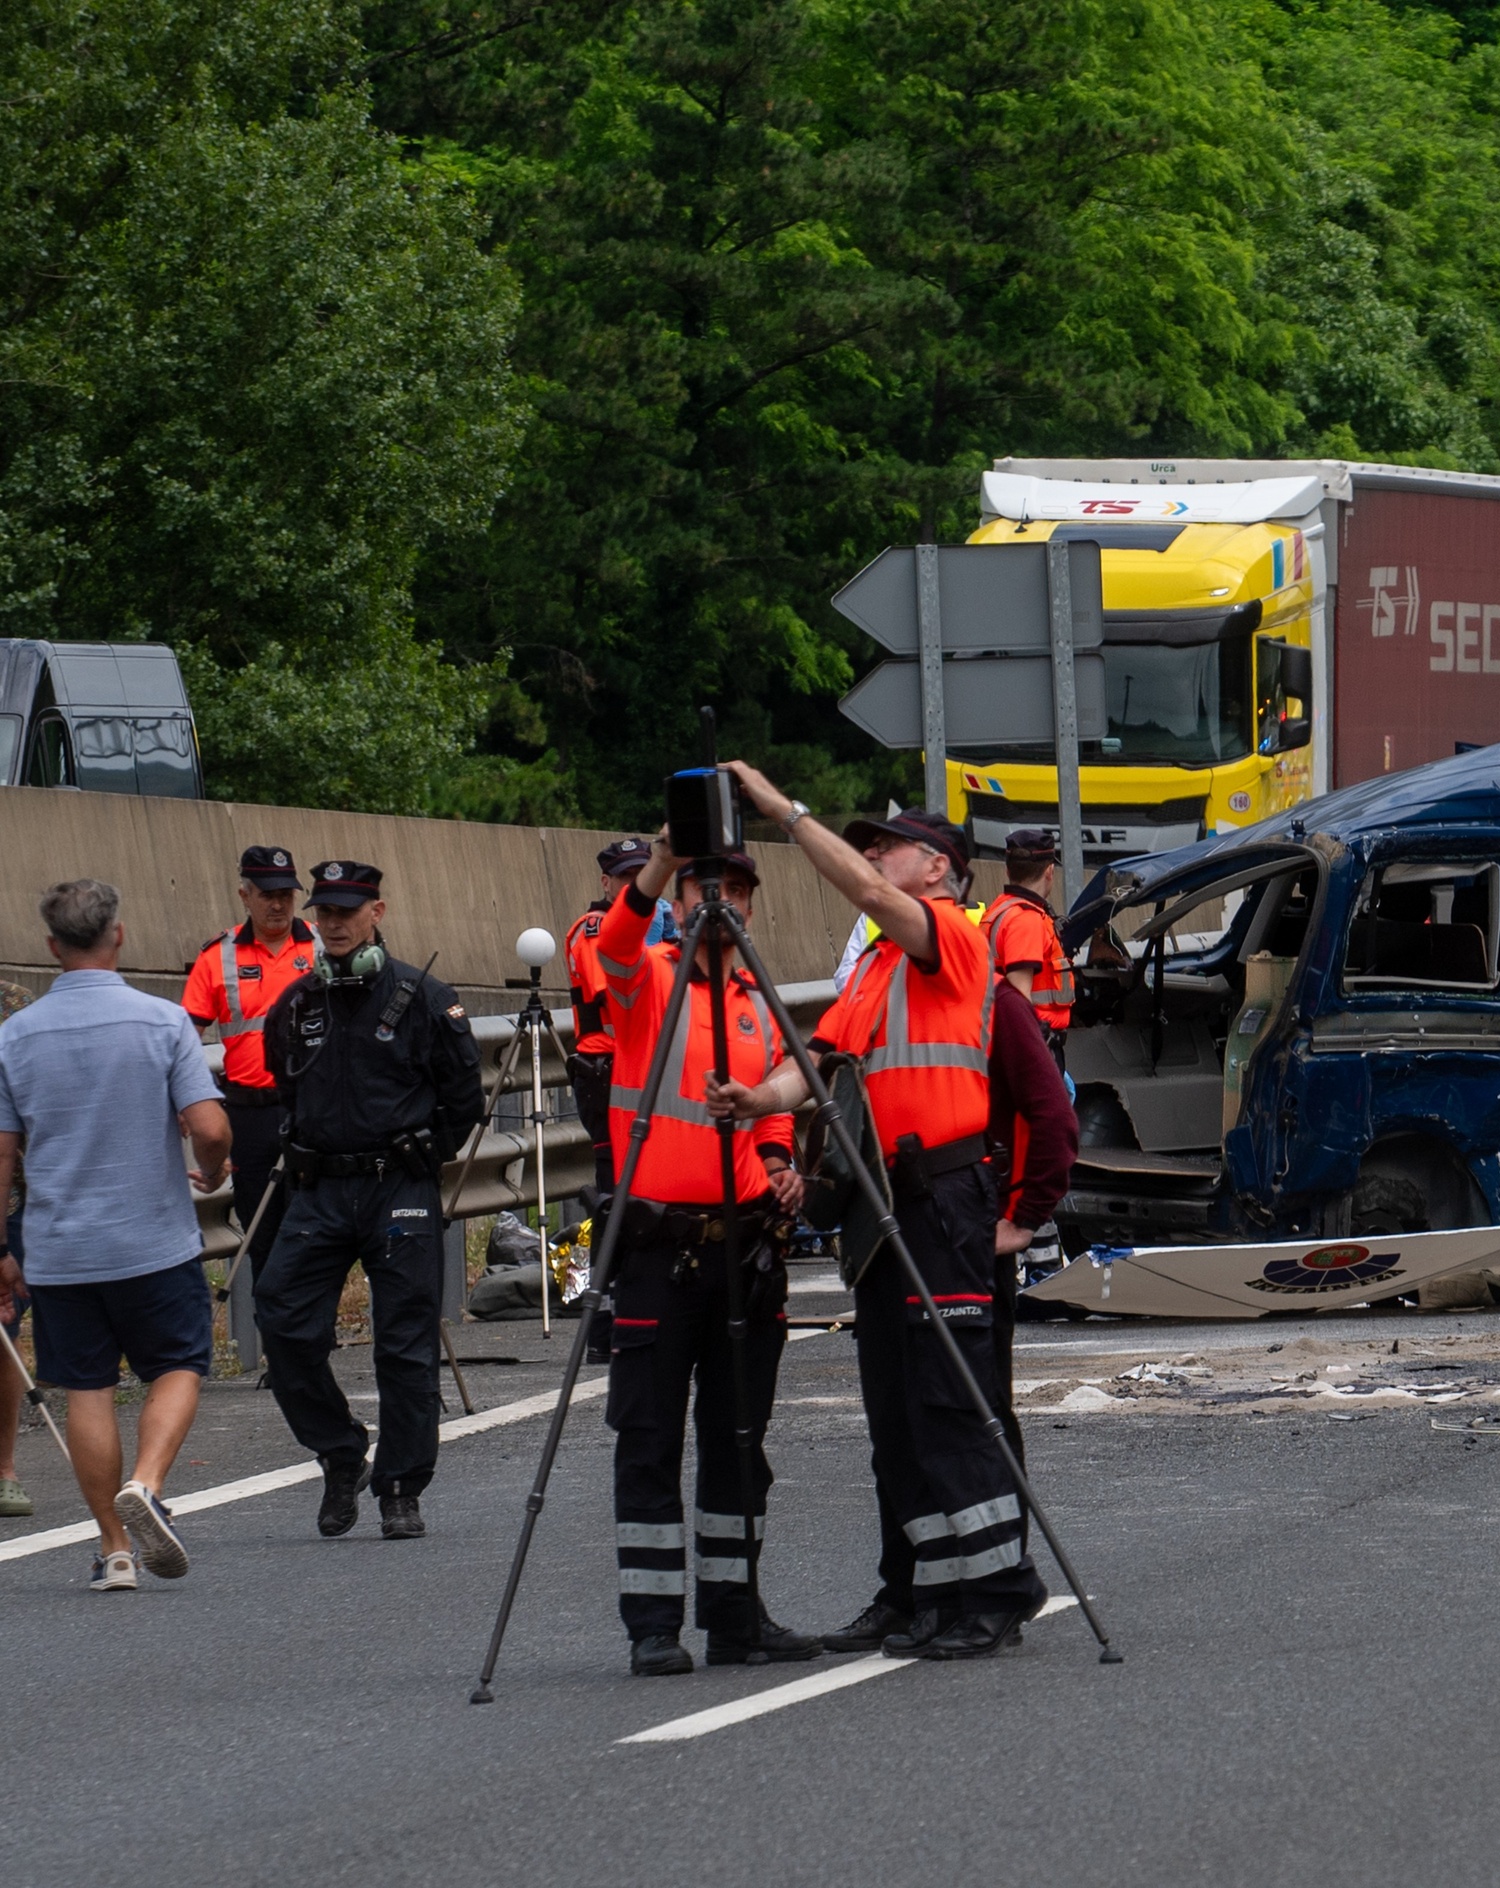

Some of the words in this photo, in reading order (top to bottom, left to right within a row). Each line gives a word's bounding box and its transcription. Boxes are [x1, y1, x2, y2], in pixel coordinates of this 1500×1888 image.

[1151, 463, 1176, 473] Urca
[1079, 500, 1142, 514] TS
[923, 1306, 983, 1320] ETZAINTZA
